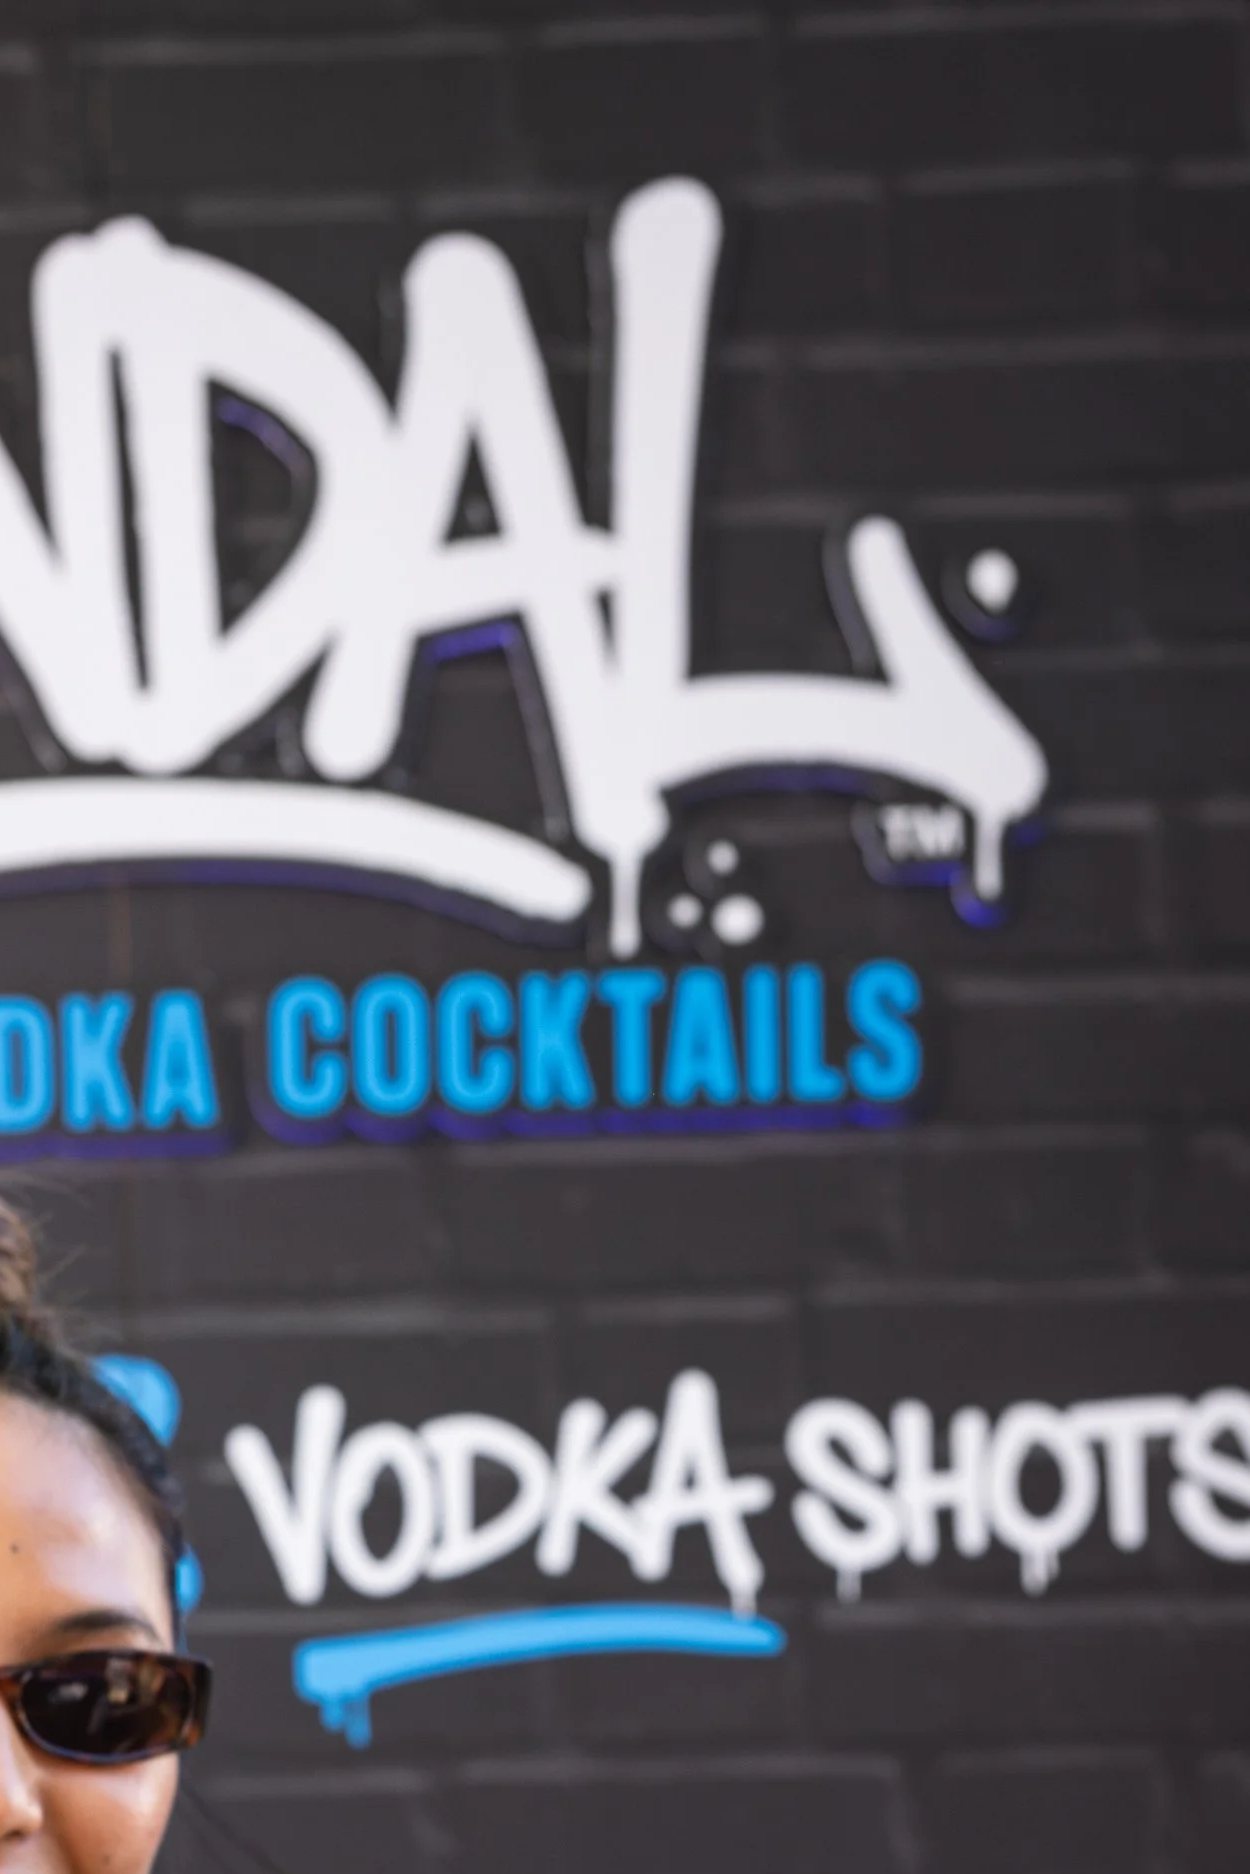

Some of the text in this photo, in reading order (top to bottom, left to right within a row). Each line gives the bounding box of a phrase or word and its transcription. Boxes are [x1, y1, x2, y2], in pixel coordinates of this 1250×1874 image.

[267, 960, 923, 1120] COCKTAILS
[224, 1368, 774, 1617] VODKA
[786, 1386, 1250, 1601] SHOTS
